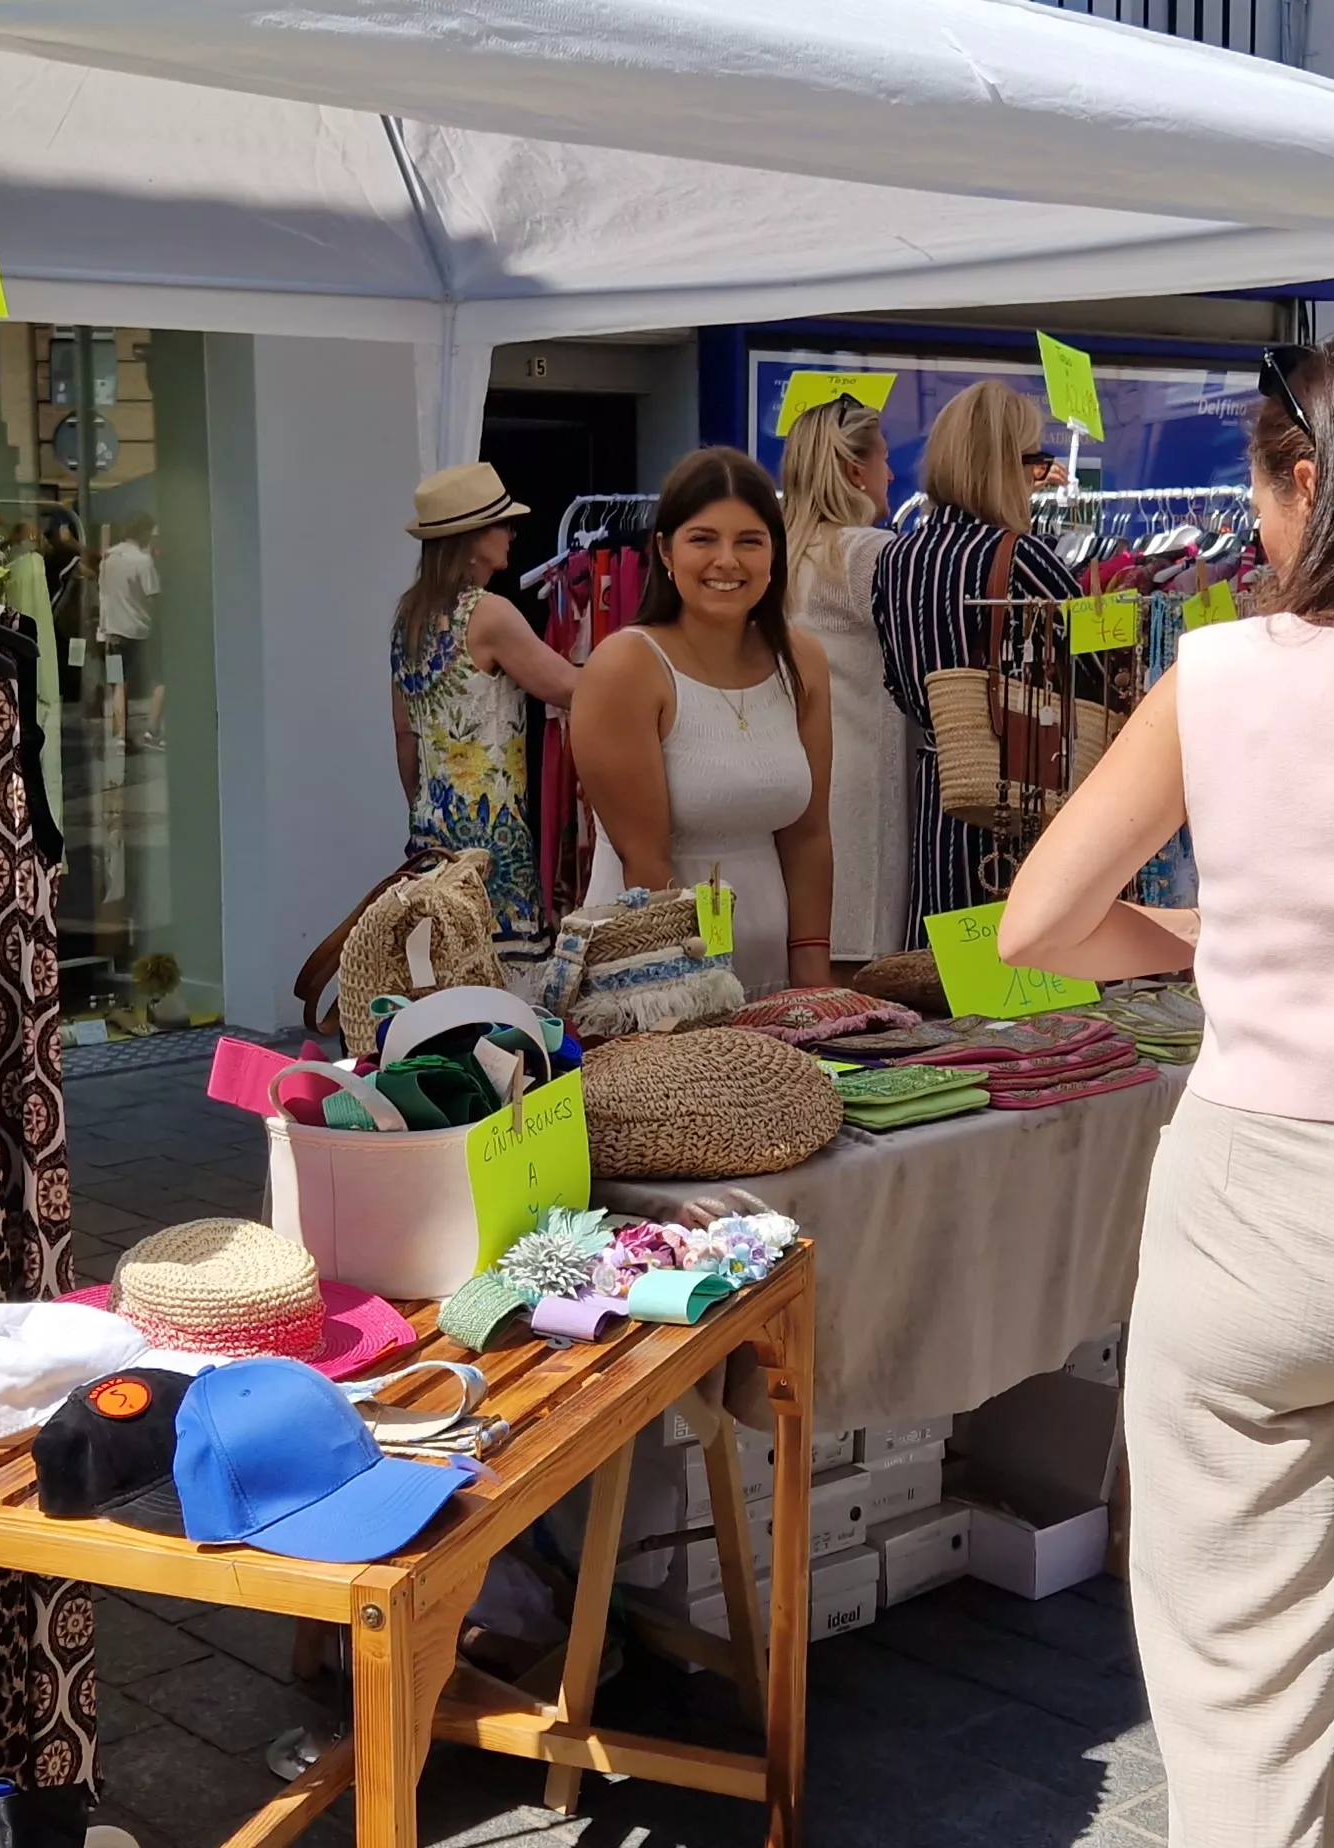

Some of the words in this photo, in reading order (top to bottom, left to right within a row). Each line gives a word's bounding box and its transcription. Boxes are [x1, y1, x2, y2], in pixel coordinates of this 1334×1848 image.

[526, 357, 546, 377] 15
[528, 1161, 539, 1189] A
[827, 1604, 861, 1629] ideal
